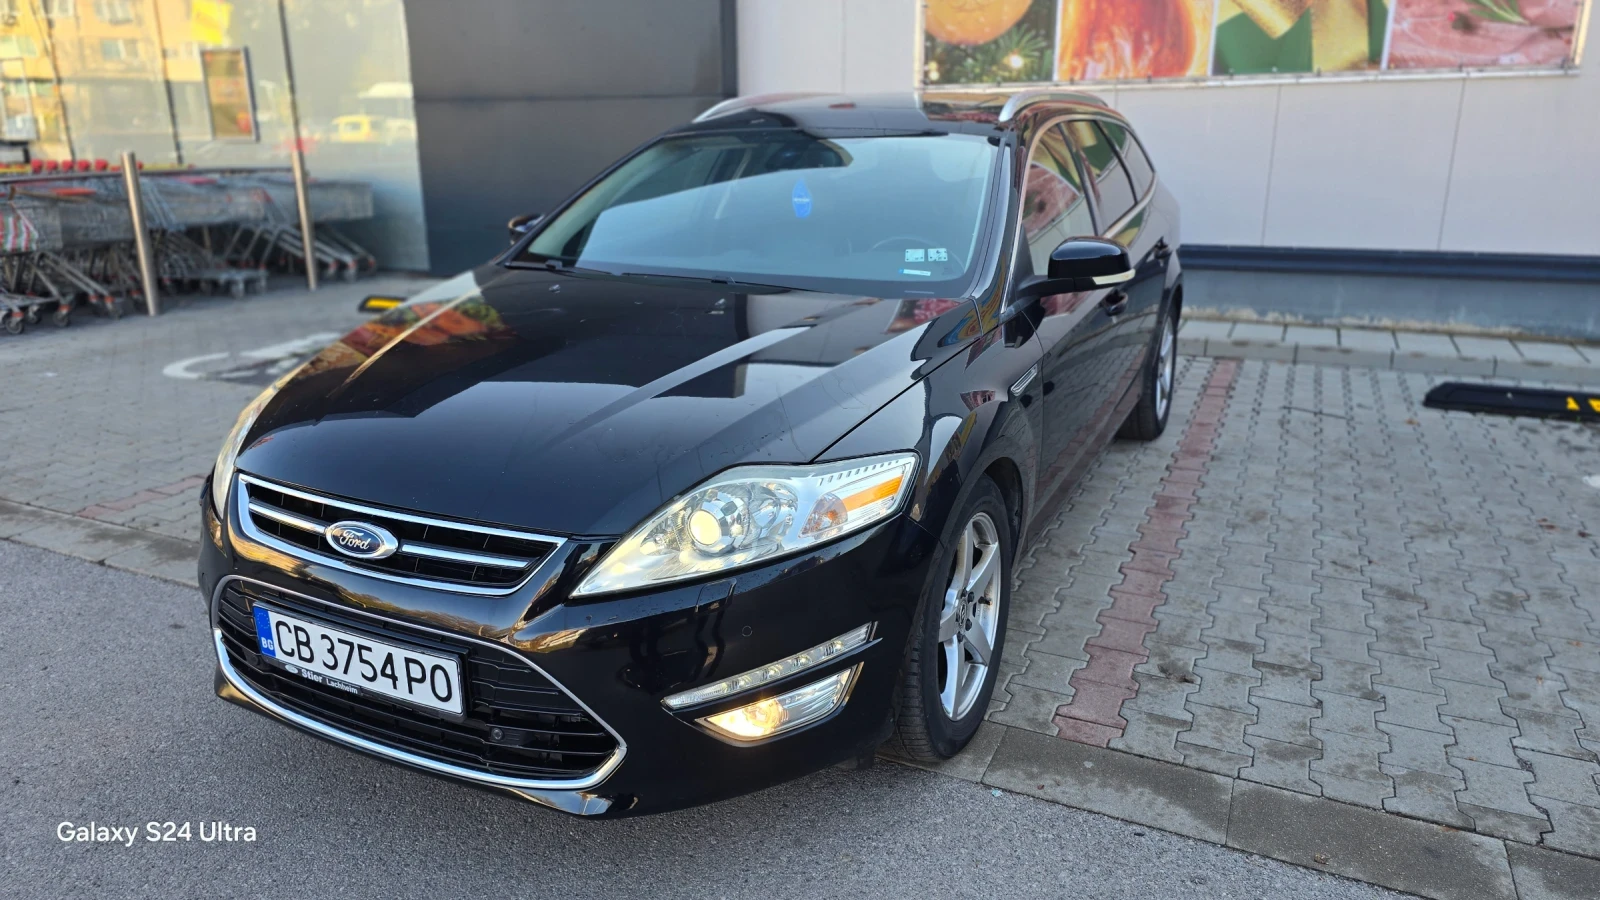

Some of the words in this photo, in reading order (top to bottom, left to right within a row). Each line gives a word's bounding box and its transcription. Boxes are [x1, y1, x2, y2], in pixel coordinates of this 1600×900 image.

[339, 529, 371, 550] Ford
[261, 637, 274, 651] BG
[275, 620, 314, 663] CB
[321, 633, 398, 690] 3754
[301, 668, 323, 683] Stier
